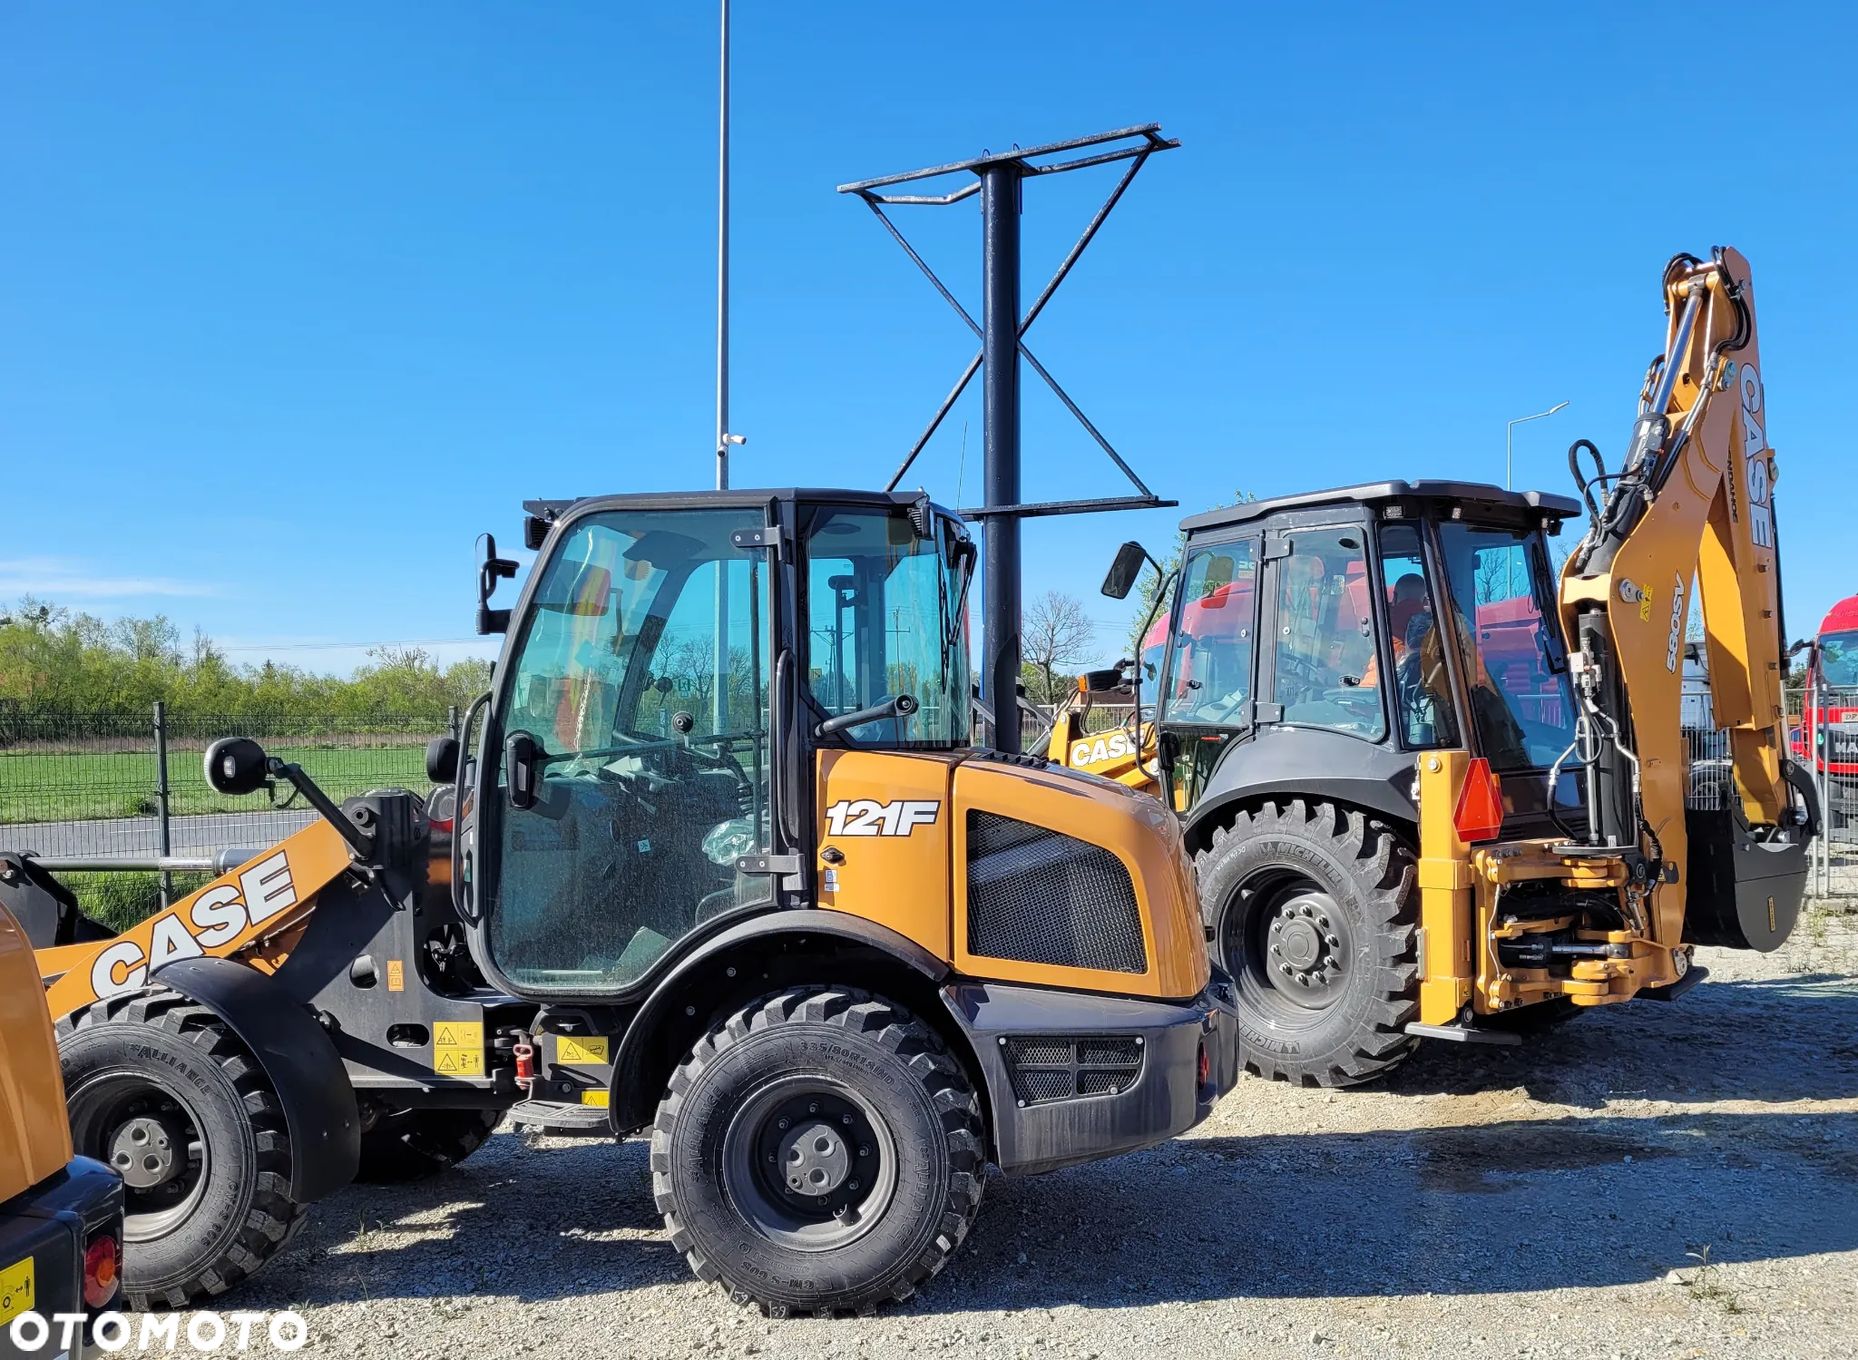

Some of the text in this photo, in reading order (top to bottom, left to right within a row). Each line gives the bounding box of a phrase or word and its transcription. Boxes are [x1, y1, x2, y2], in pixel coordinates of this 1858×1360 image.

[1740, 362, 1772, 549] CASE
[1665, 568, 1685, 674] 580SV
[825, 799, 942, 837] 121F
[1277, 842, 1343, 883] MICHELIN
[91, 849, 298, 1001] CASE
[138, 1043, 213, 1096] ALLIANCE
